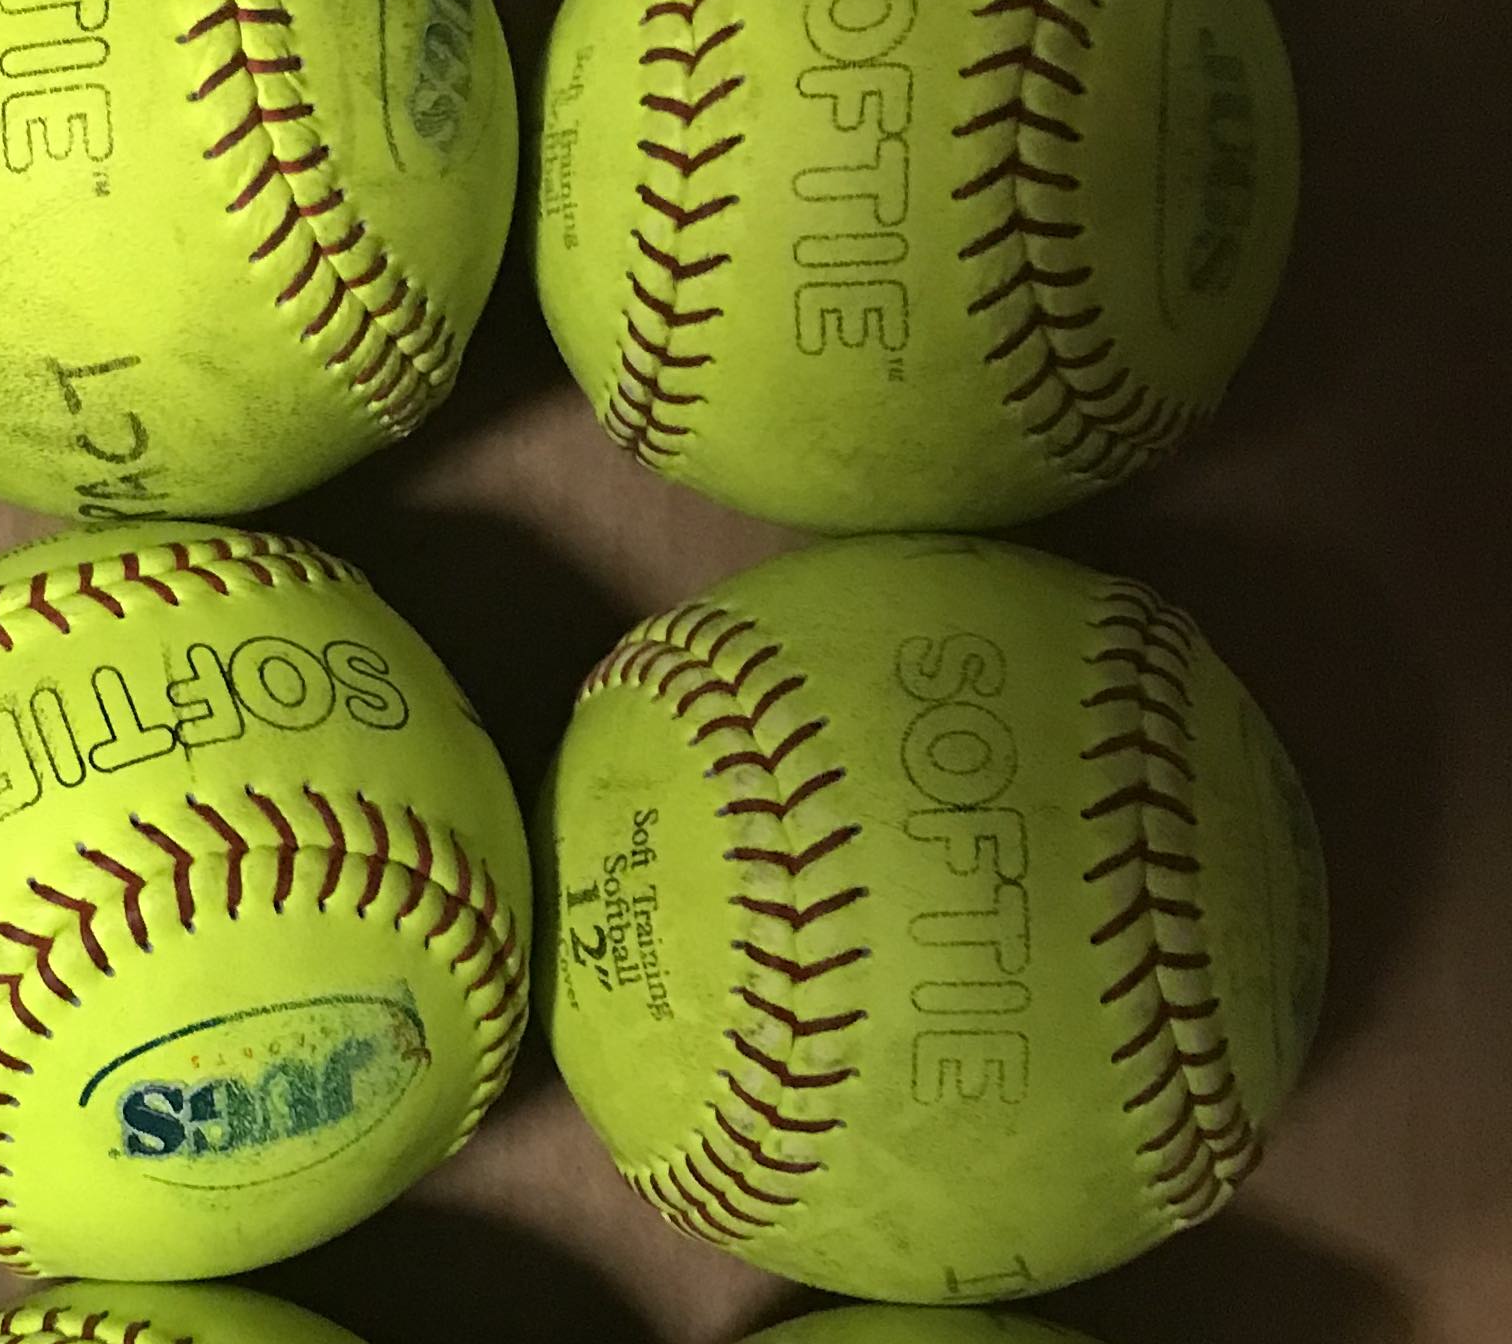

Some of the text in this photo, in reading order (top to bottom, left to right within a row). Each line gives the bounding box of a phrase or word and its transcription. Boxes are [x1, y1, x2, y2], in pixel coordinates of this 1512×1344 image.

[603, 852, 642, 988] Softball
[630, 807, 676, 1023] Soft Training
[894, 631, 1032, 1107] SOFTIE
